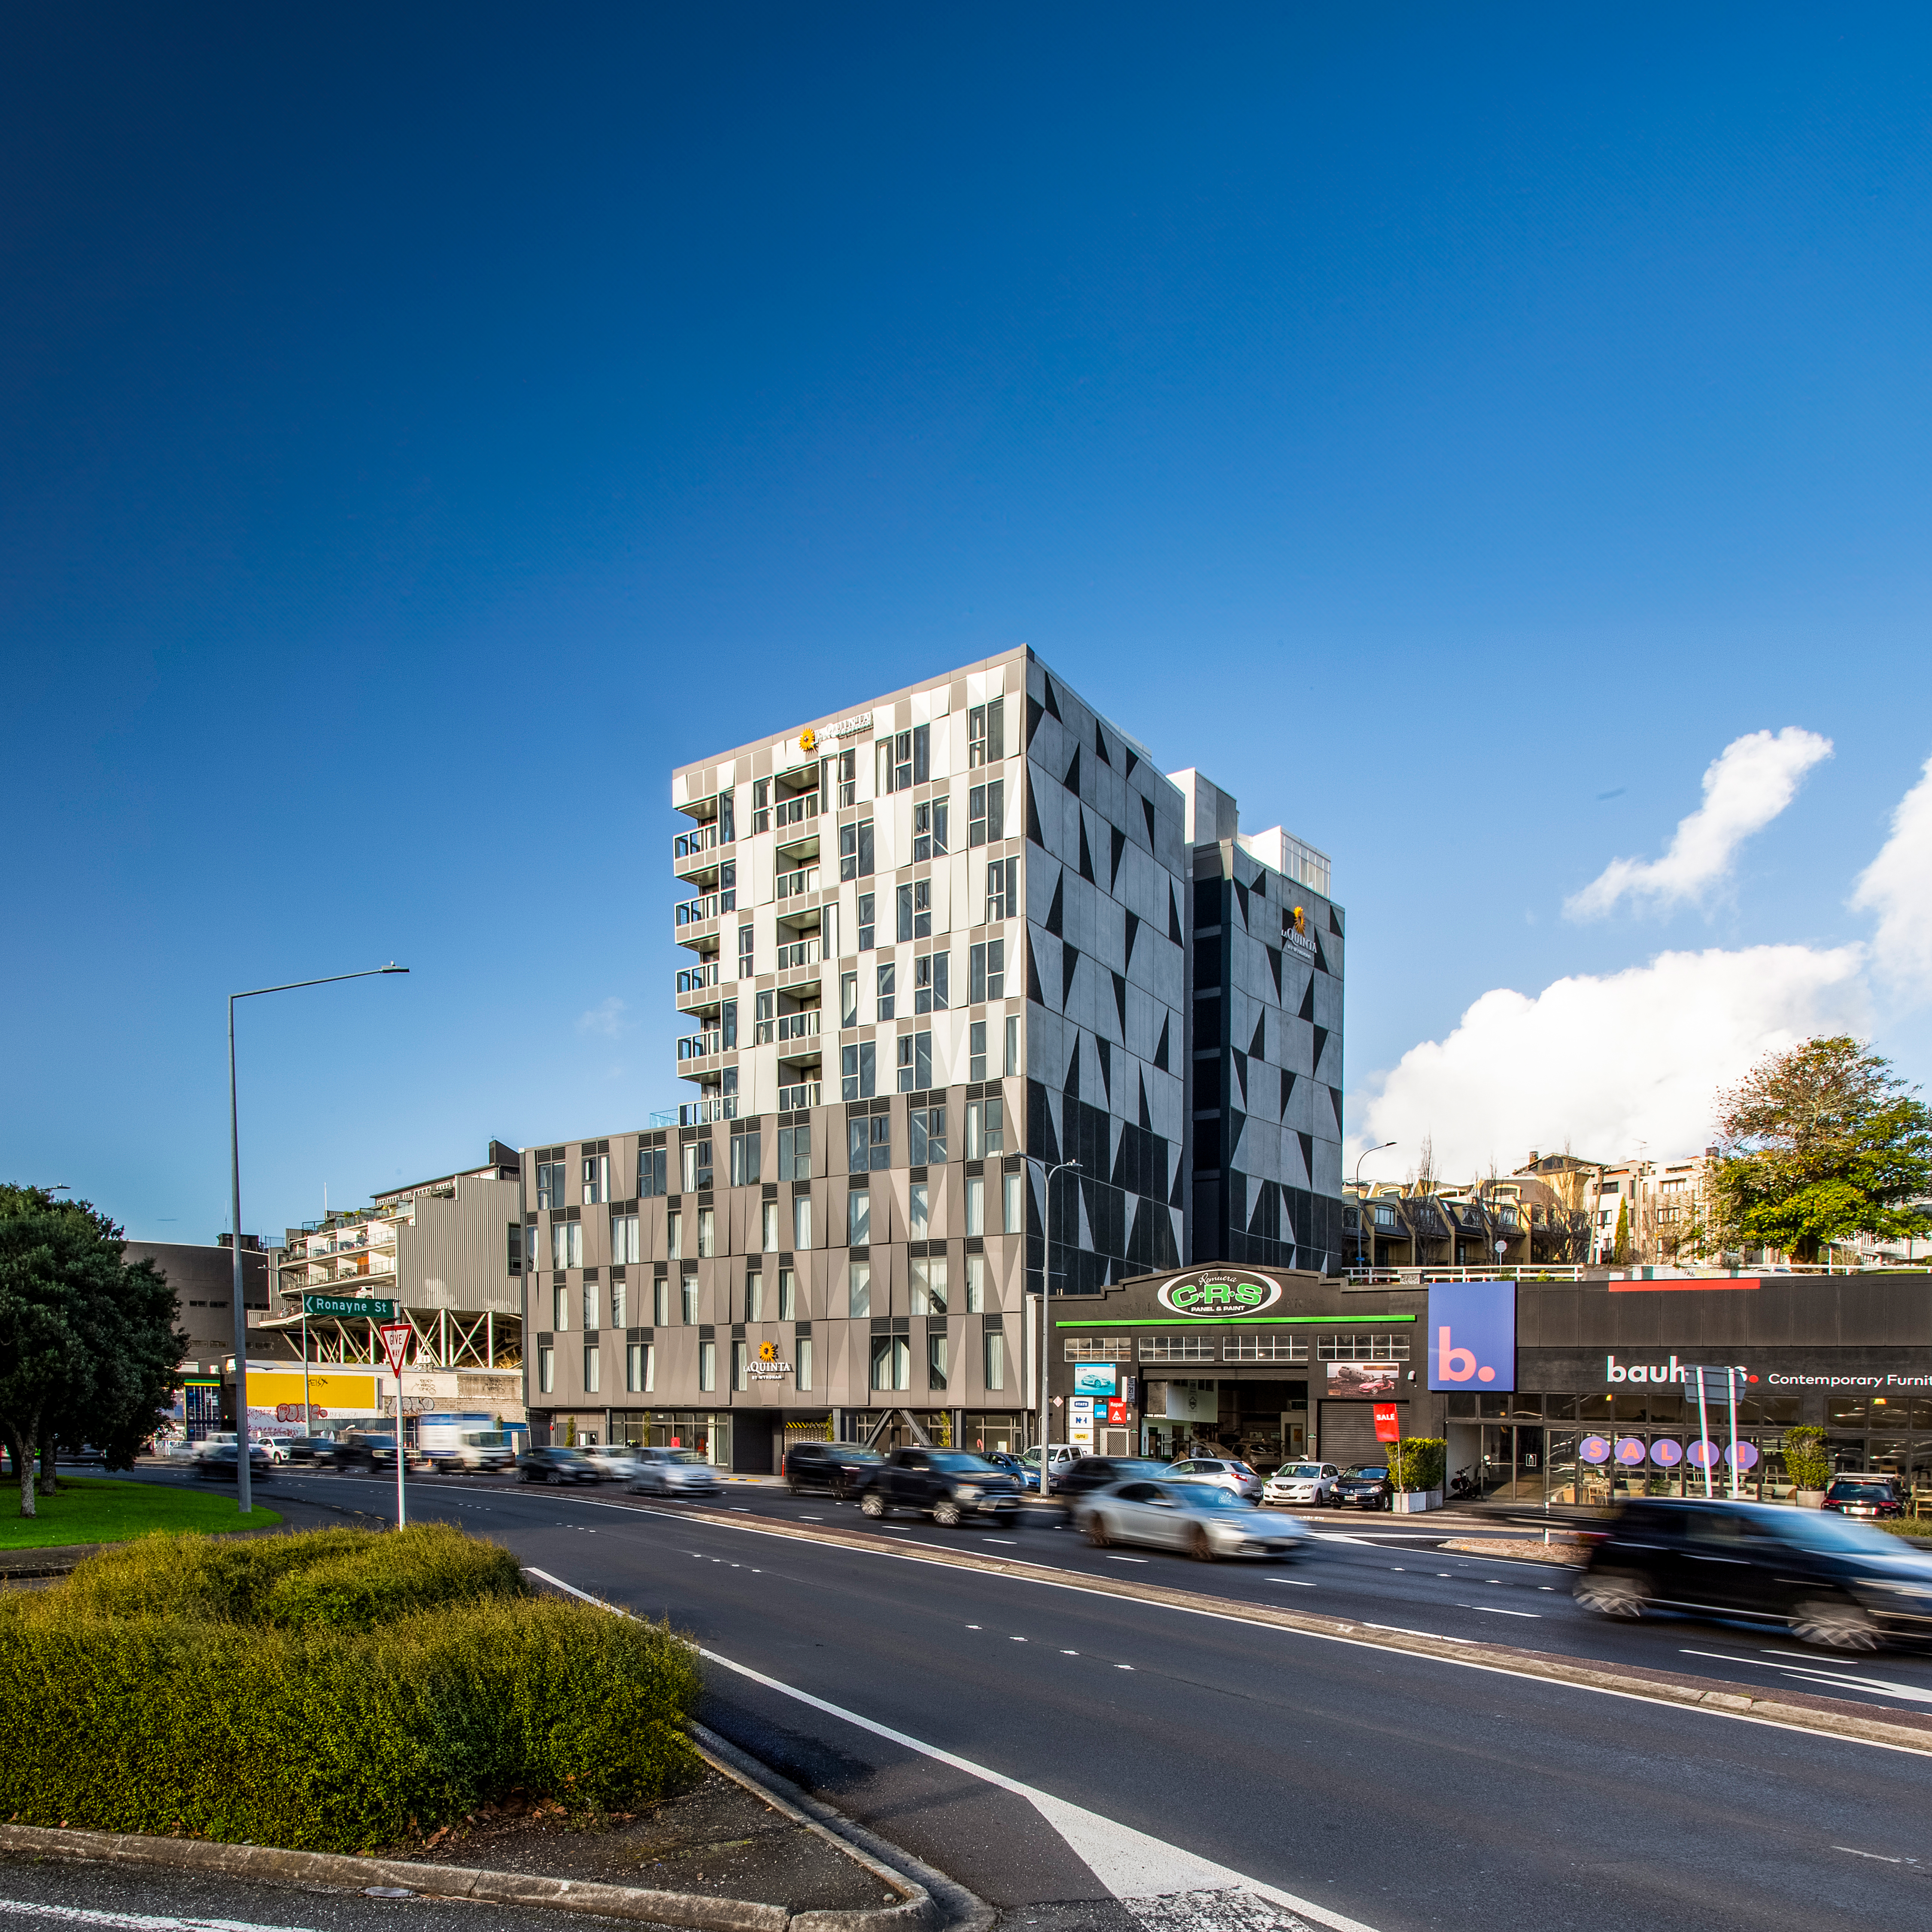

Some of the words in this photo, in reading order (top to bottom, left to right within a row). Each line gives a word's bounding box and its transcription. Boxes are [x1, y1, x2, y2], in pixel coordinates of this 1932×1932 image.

[1287, 928, 1317, 954] QUINTA
[1198, 1273, 1237, 1285] Remuera
[316, 1298, 367, 1313] Ronayne
[374, 1301, 386, 1312] St
[389, 1334, 402, 1345] GIVE
[750, 1361, 790, 1374] QUINTA
[1768, 1373, 1883, 1388] Contemporary
